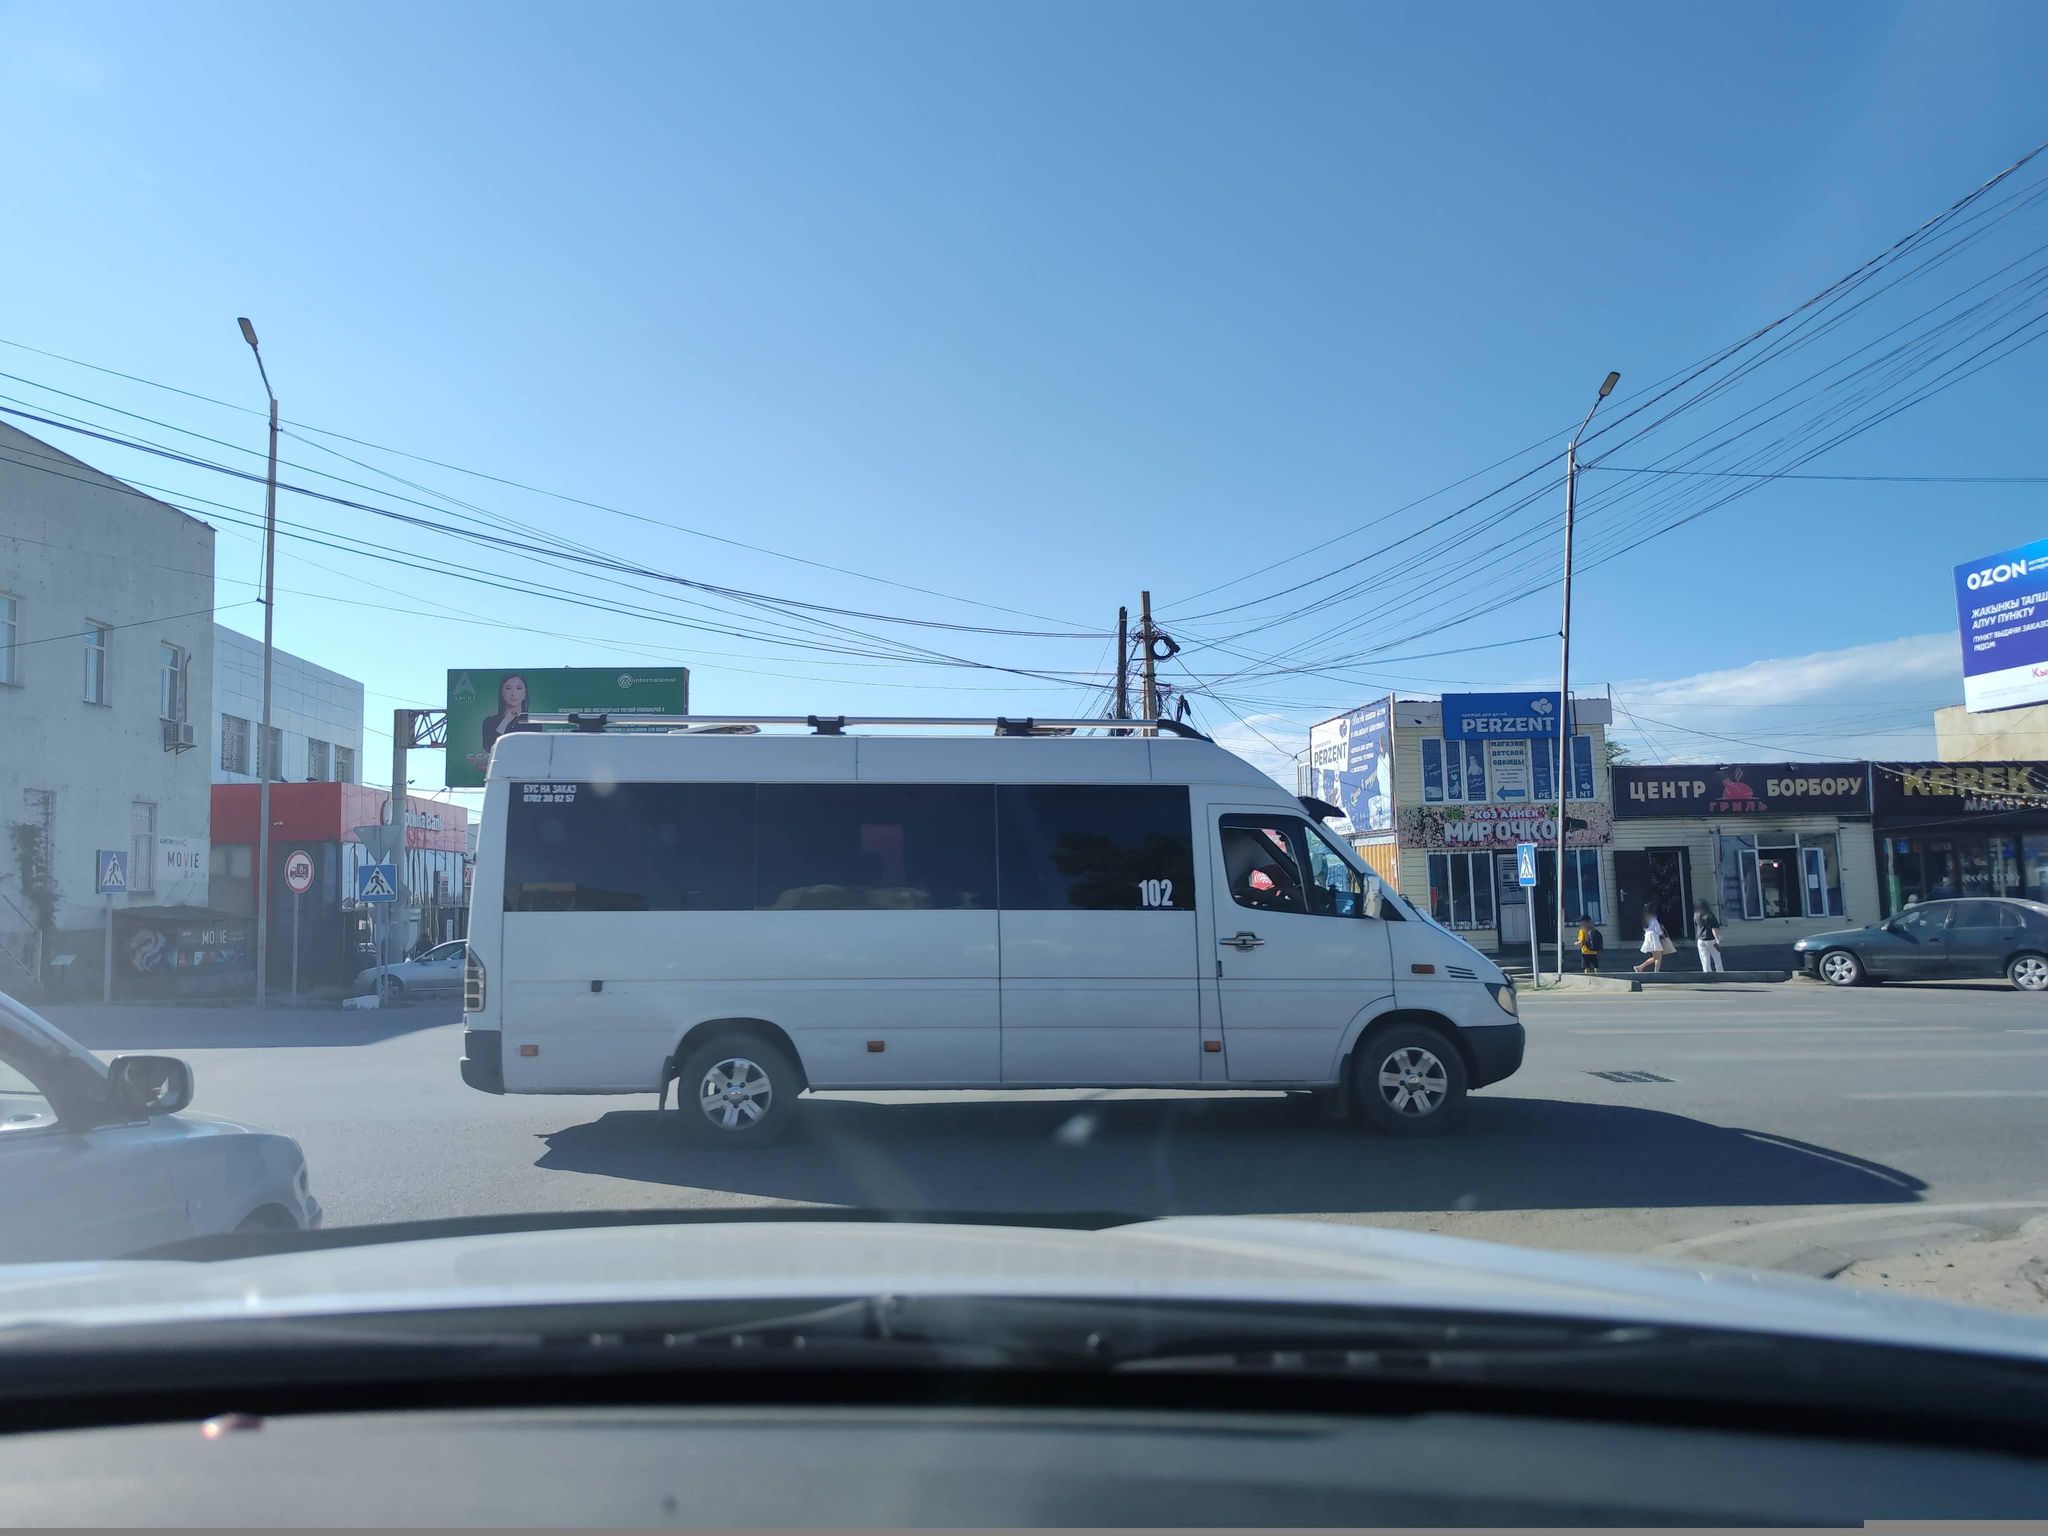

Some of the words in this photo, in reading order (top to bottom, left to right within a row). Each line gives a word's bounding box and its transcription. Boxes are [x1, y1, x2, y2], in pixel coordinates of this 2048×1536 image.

[1967, 559, 2027, 590] OZON
[1971, 598, 2020, 619] ЖАКЫНКЫ
[1972, 615, 1997, 630] АЛУУ
[1997, 606, 2035, 624] ПУНКТУ
[634, 676, 676, 684] international
[1461, 717, 1554, 733] PERZENT
[1314, 741, 1347, 767] PERZENT
[1629, 780, 1706, 802] ЦЕНТР
[1766, 776, 1862, 797] БОРБОРУ
[1708, 801, 1768, 812] ГРИЛЬ
[1444, 821, 1493, 843] МИР
[1495, 819, 1559, 841] ОЧКО
[167, 851, 200, 868] MOVIE
[1137, 878, 1174, 907] 102
